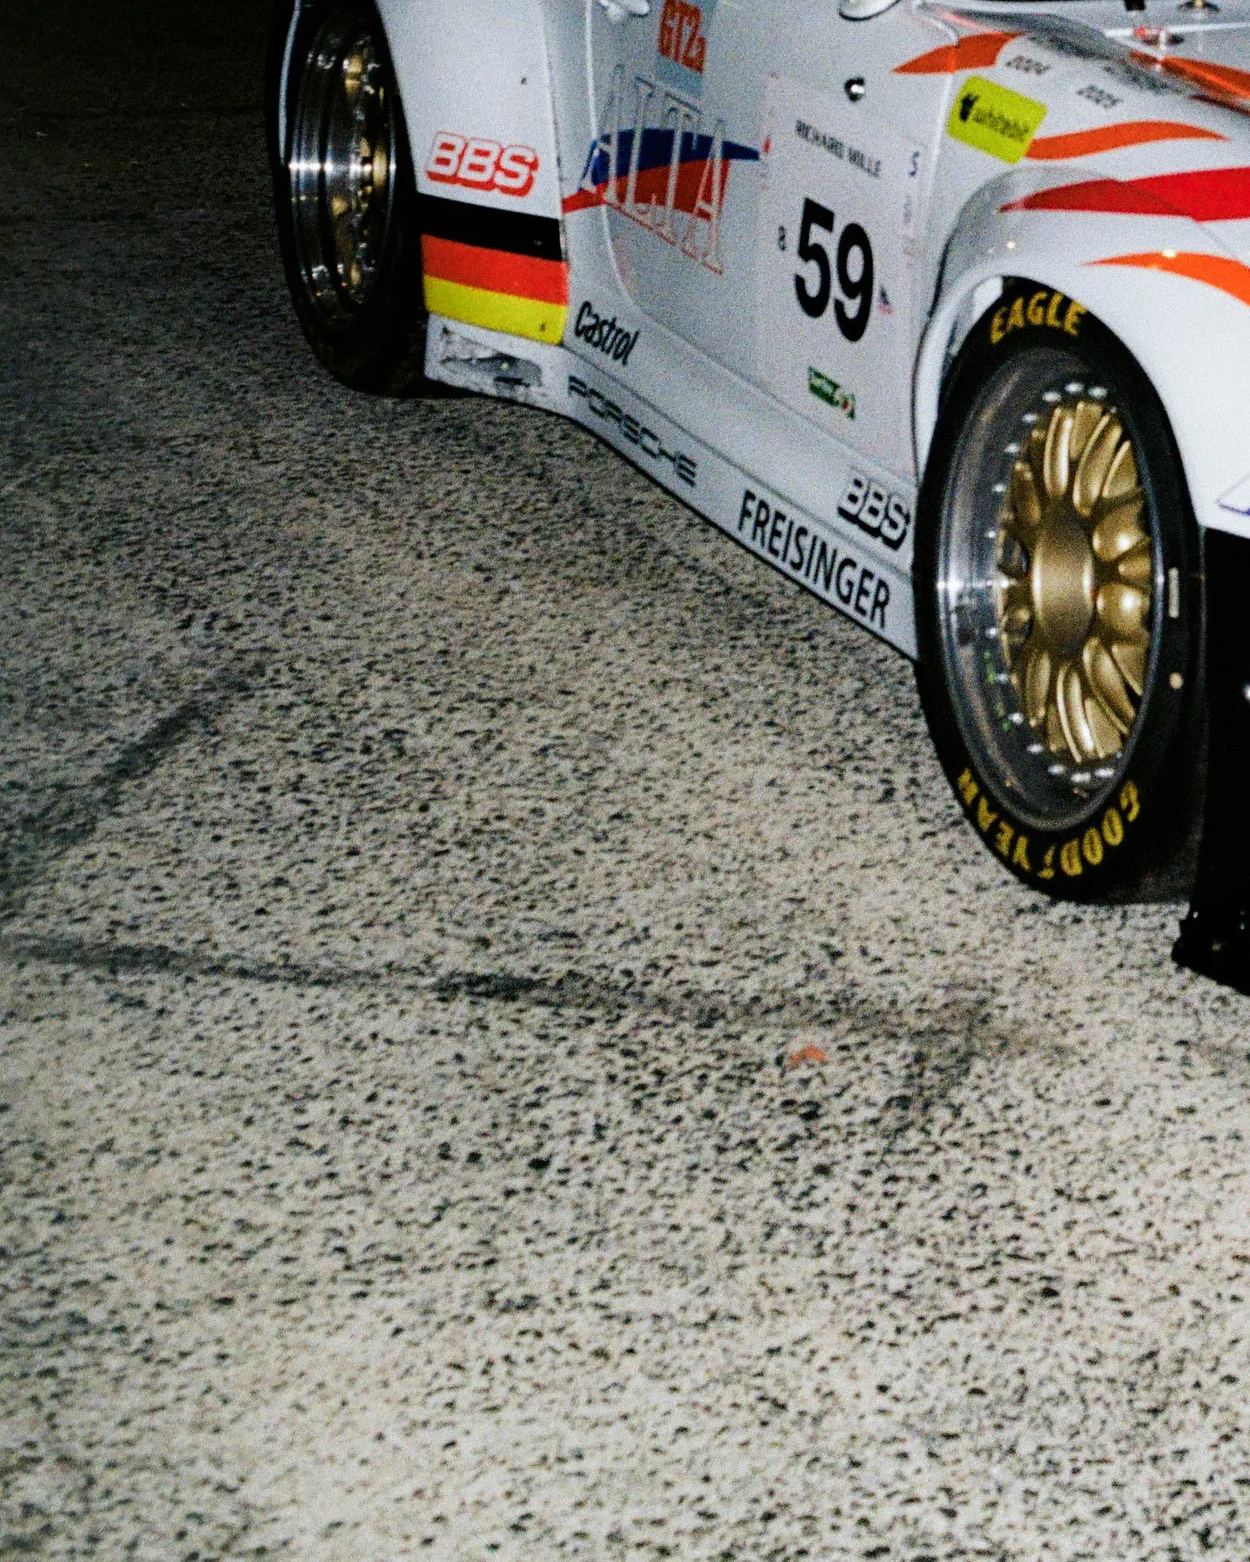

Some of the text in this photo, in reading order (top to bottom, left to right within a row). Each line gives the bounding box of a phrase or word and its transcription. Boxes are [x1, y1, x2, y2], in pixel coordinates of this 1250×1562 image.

[425, 132, 539, 197] BBS
[794, 198, 874, 342] 59
[574, 301, 640, 366] Castrol
[989, 289, 1089, 344] EAGLE
[567, 375, 697, 488] PORSCHE
[837, 475, 910, 551] BBS
[737, 490, 890, 631] FREISINGER
